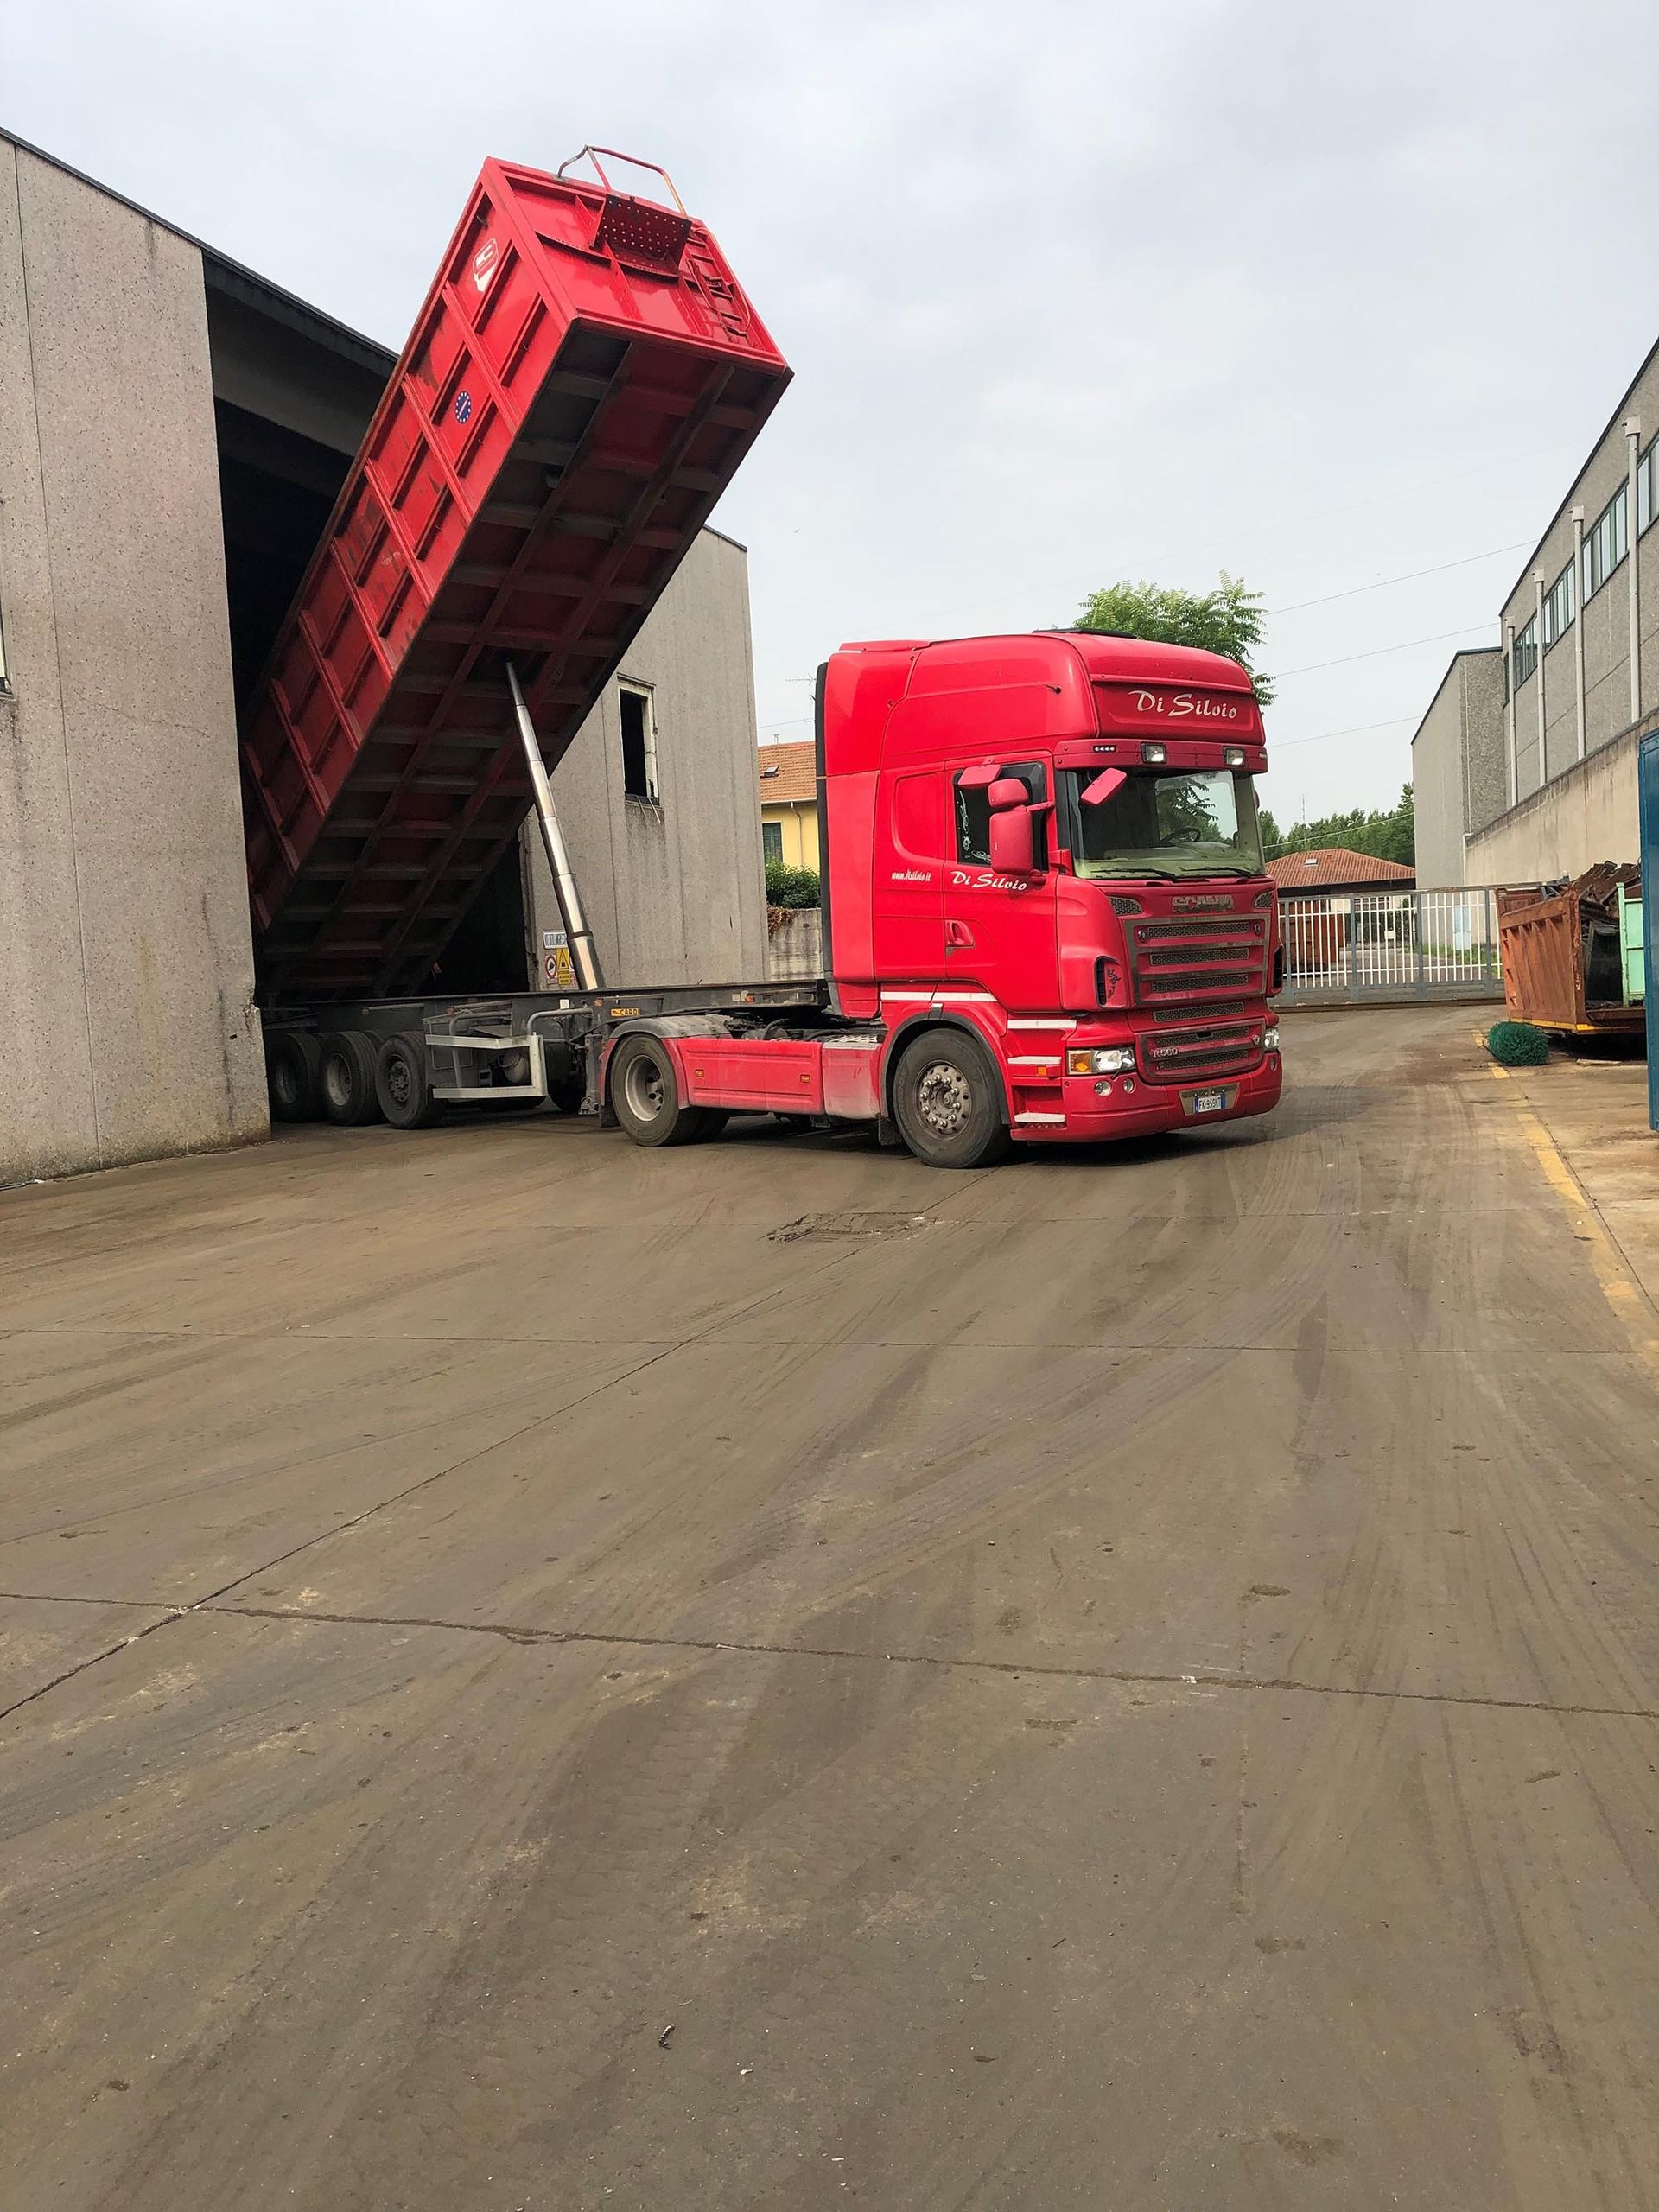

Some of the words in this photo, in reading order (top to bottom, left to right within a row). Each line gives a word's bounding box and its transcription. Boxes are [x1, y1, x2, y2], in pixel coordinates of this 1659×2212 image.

[1128, 690, 1165, 713] Di
[1167, 693, 1237, 719] Silvio
[950, 870, 970, 885] Di
[971, 873, 1027, 891] Silvio
[1172, 893, 1235, 912] SCANIA
[1151, 1047, 1179, 1058] R560
